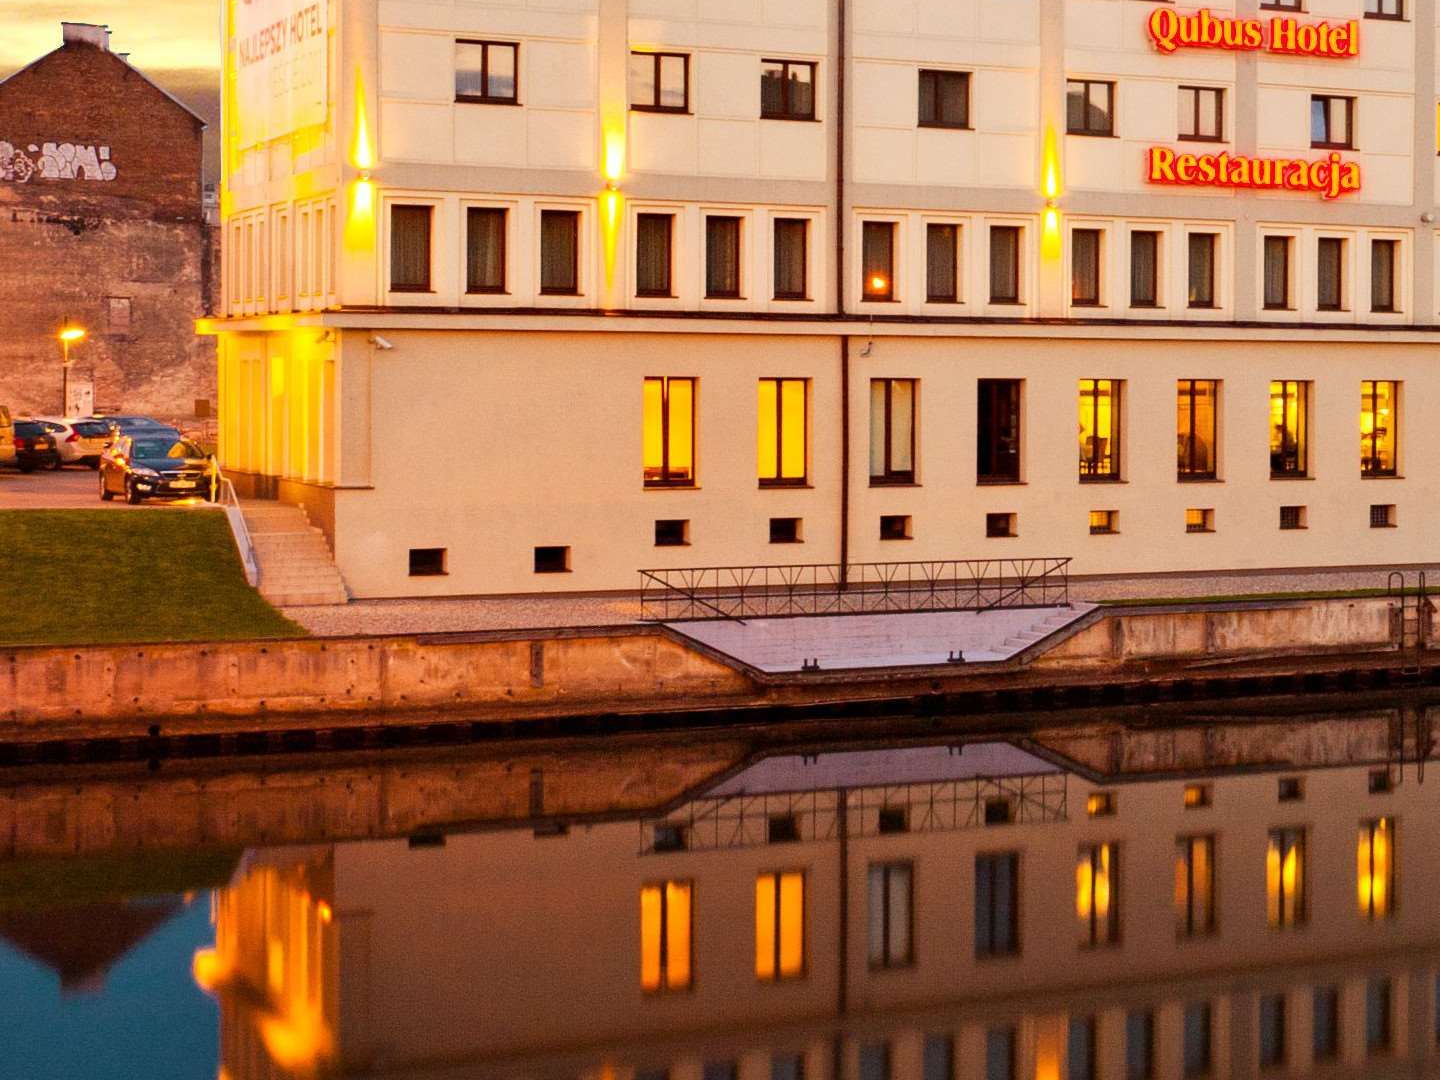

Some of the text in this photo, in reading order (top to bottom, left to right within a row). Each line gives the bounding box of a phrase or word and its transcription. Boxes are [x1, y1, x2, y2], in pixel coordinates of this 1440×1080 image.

[288, 2, 323, 45] HOTEL
[1149, 6, 1359, 57] Qubus Hotel
[1149, 146, 1361, 199] Restauracja
